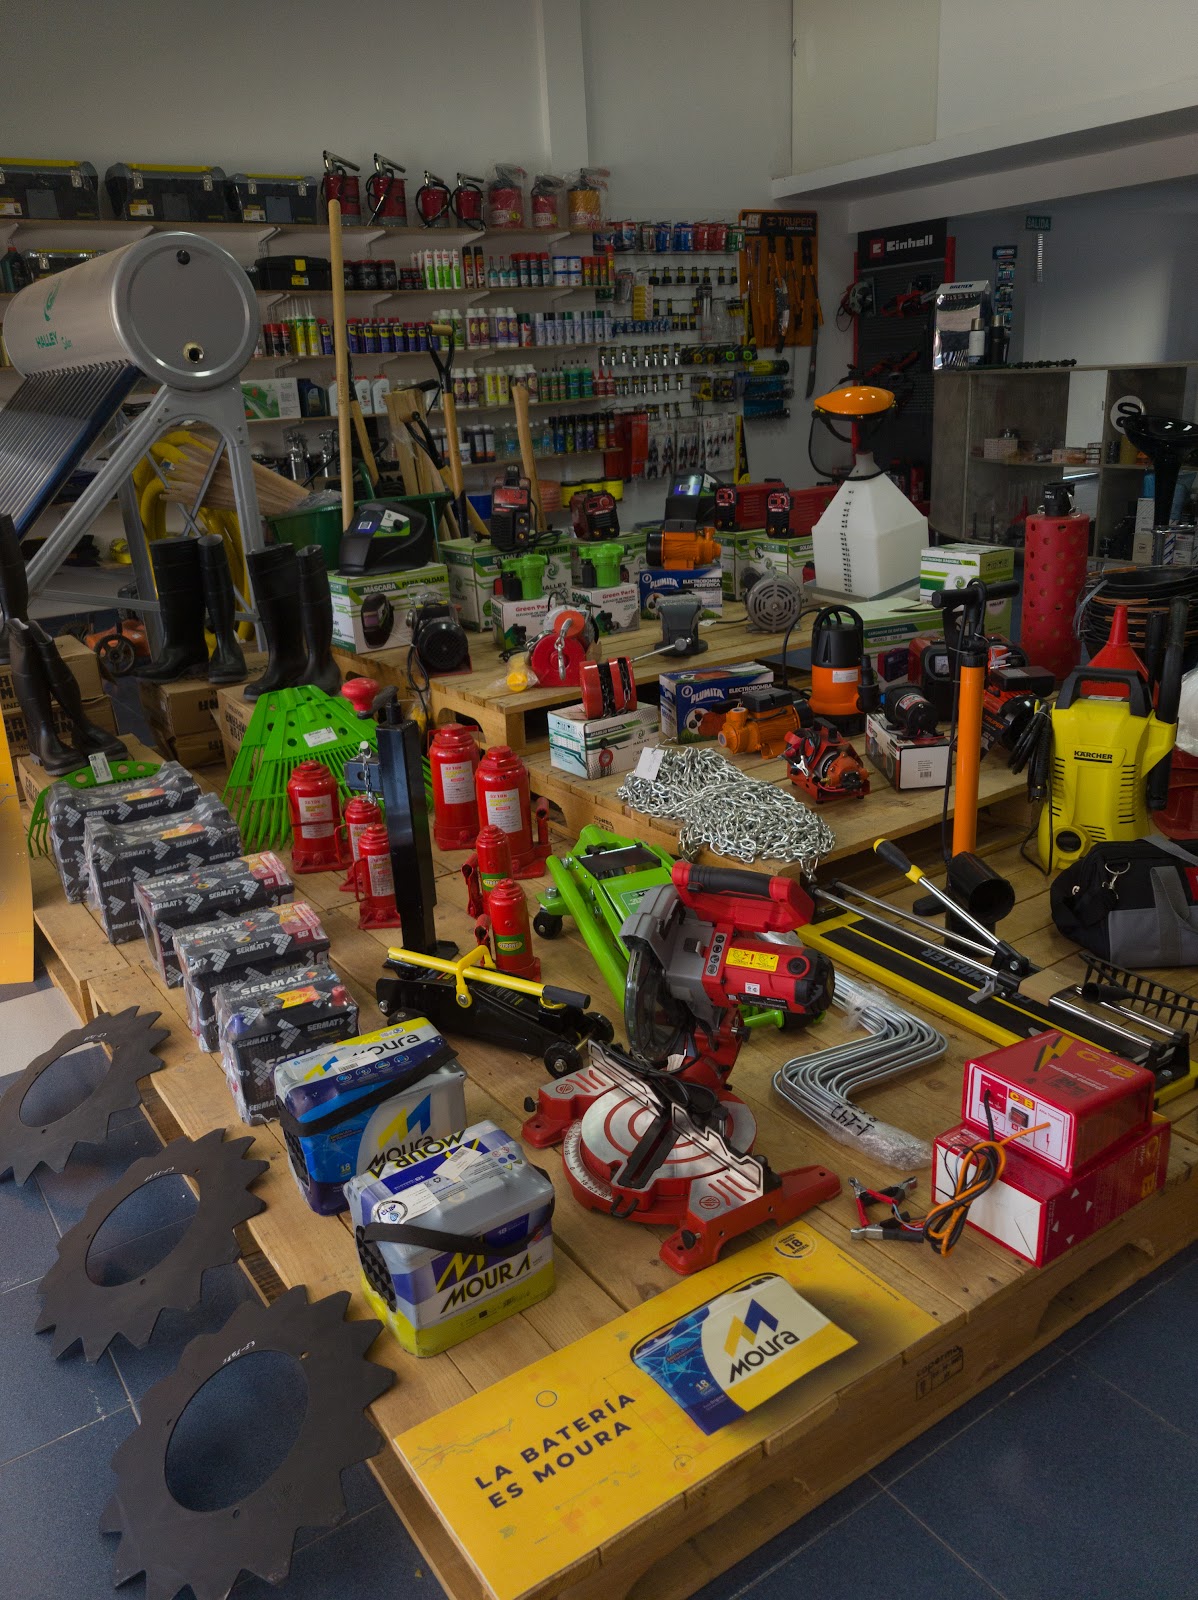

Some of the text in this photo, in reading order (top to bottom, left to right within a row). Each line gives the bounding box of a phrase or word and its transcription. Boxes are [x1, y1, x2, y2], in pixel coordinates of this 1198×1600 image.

[778, 216, 813, 226] TRUPER
[1026, 218, 1050, 230] SALIDA
[886, 235, 934, 252] Einhell
[35, 331, 59, 349] HALLEY
[650, 578, 679, 588] PLUMITA
[728, 682, 772, 694] ELECTROBOMBA
[690, 687, 724, 704] PLUMITA
[984, 716, 1005, 730] TRUPER
[1074, 750, 1113, 760] KÄRCHER
[86, 808, 110, 818] SERMAT
[209, 852, 232, 861] SERMAT
[102, 878, 127, 888] SERMAT
[208, 888, 236, 900] SERMAT
[112, 920, 137, 930] SERMAT
[185, 924, 242, 940] SERMAT
[236, 943, 266, 954] SERMAT
[240, 974, 304, 995] SERMAT
[307, 1020, 339, 1032] SERMAT
[236, 1036, 270, 1048] SERMAT
[340, 1162, 350, 1172] 18
[784, 1238, 803, 1250] 18
[440, 1252, 530, 1314] MOURA
[695, 1379, 710, 1392] 18
[474, 1394, 636, 1490] LA BATERÍA
[488, 1422, 632, 1509] ES MOURA
